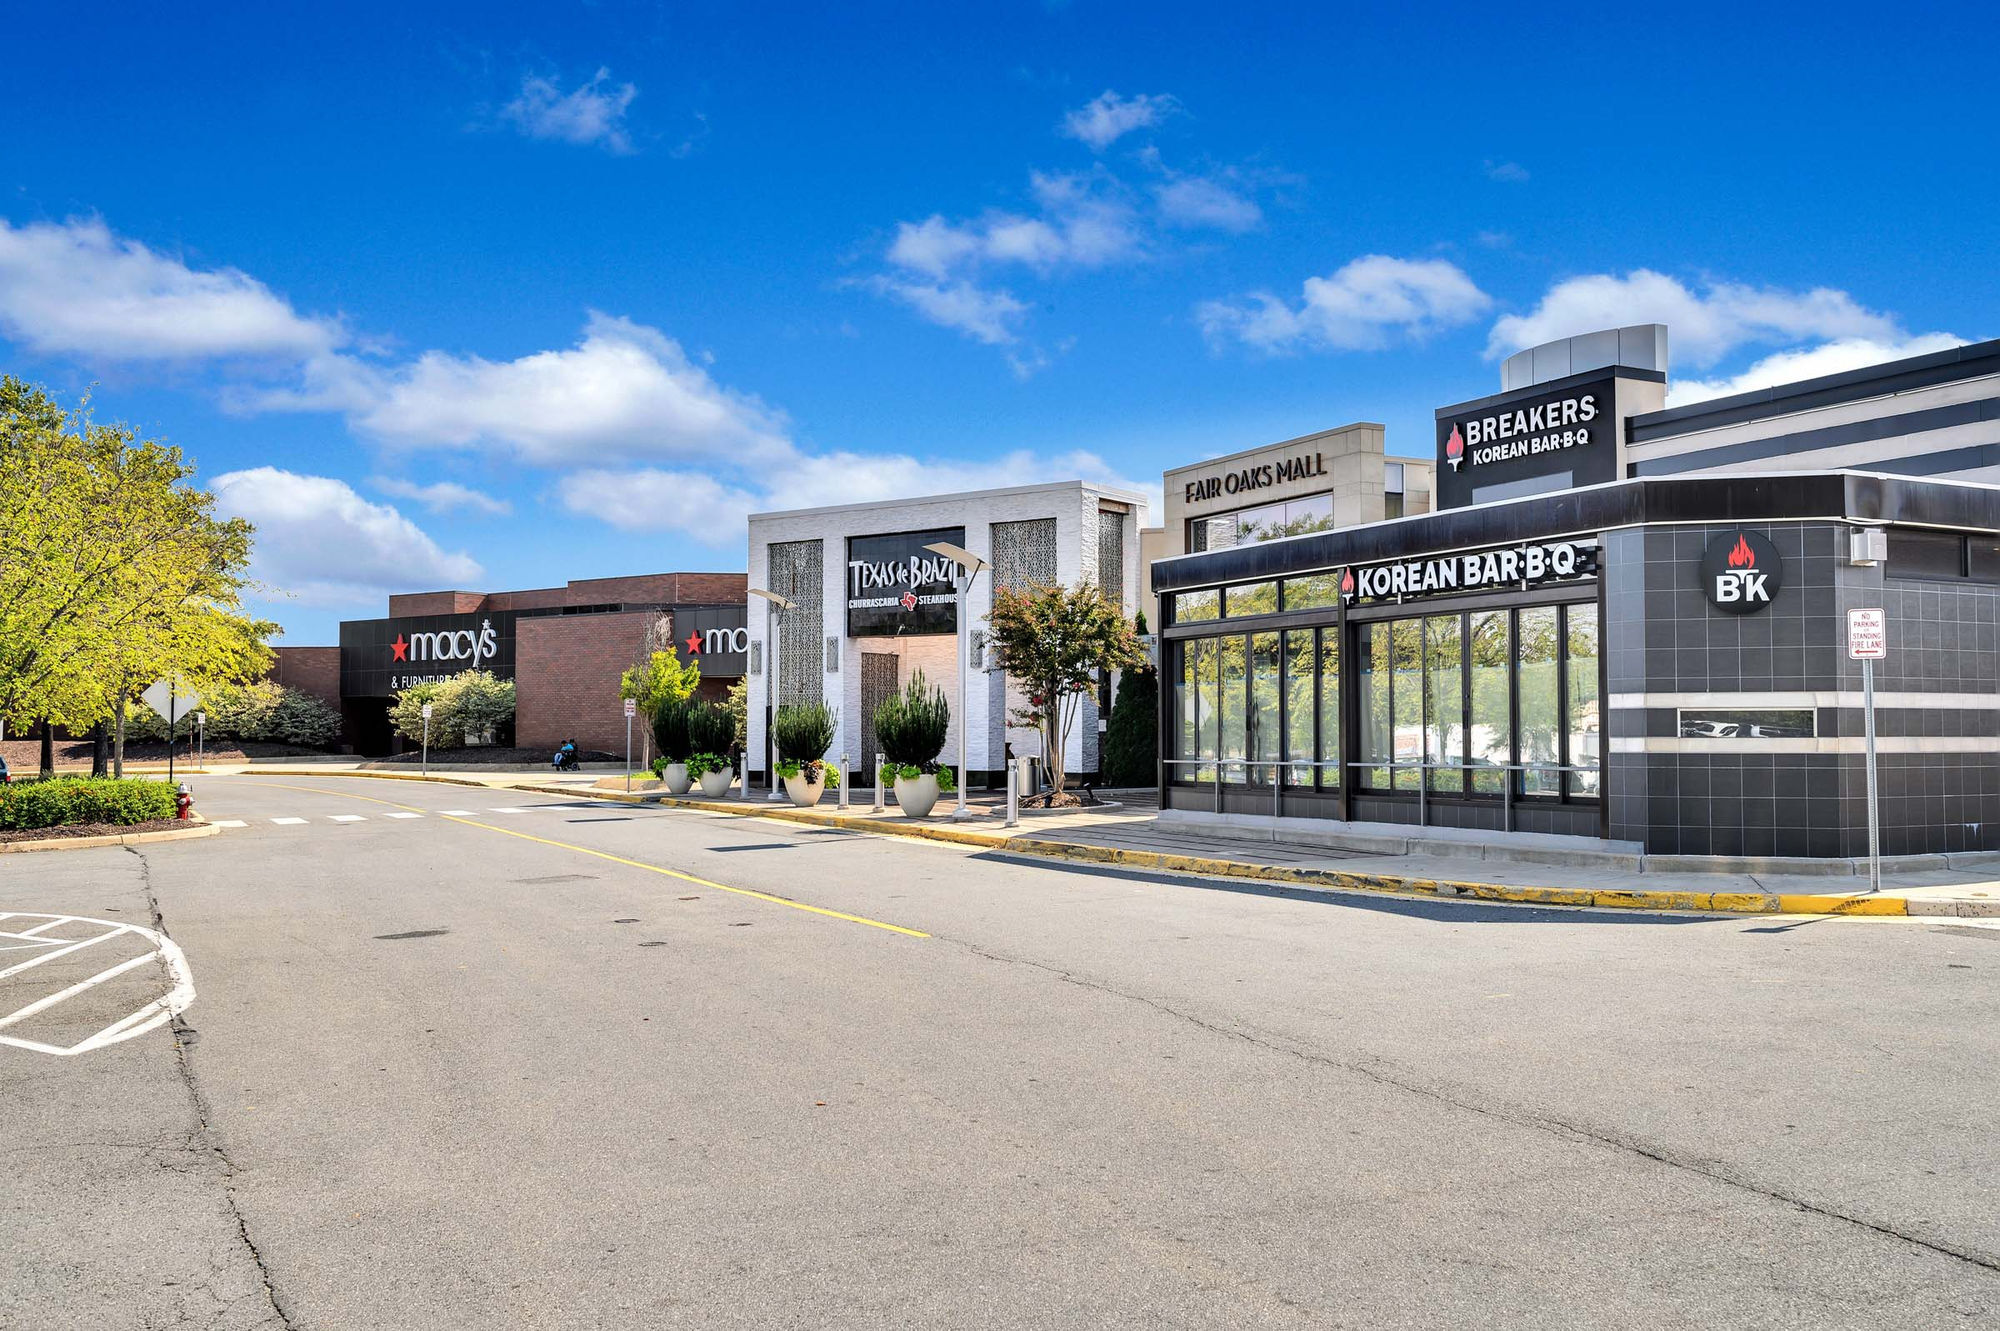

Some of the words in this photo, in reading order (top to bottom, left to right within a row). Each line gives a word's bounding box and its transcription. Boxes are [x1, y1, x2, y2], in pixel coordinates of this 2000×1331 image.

[1466, 395, 1595, 446] BREAKERS
[1473, 439, 1528, 465] KOREAN
[1185, 477, 1221, 503] FAIR
[1224, 465, 1273, 494] OAKS
[1276, 452, 1328, 484] MALL
[849, 560, 895, 597] TEXAS
[896, 562, 908, 584] de
[1358, 558, 1457, 597] KOREAN
[849, 597, 899, 608] CHURRASCARIA
[918, 593, 957, 605] STEAKHOUS
[1861, 612, 1870, 620] NO
[1851, 641, 1865, 649] FIRE
[1866, 641, 1882, 649] LANE
[391, 676, 398, 689] &
